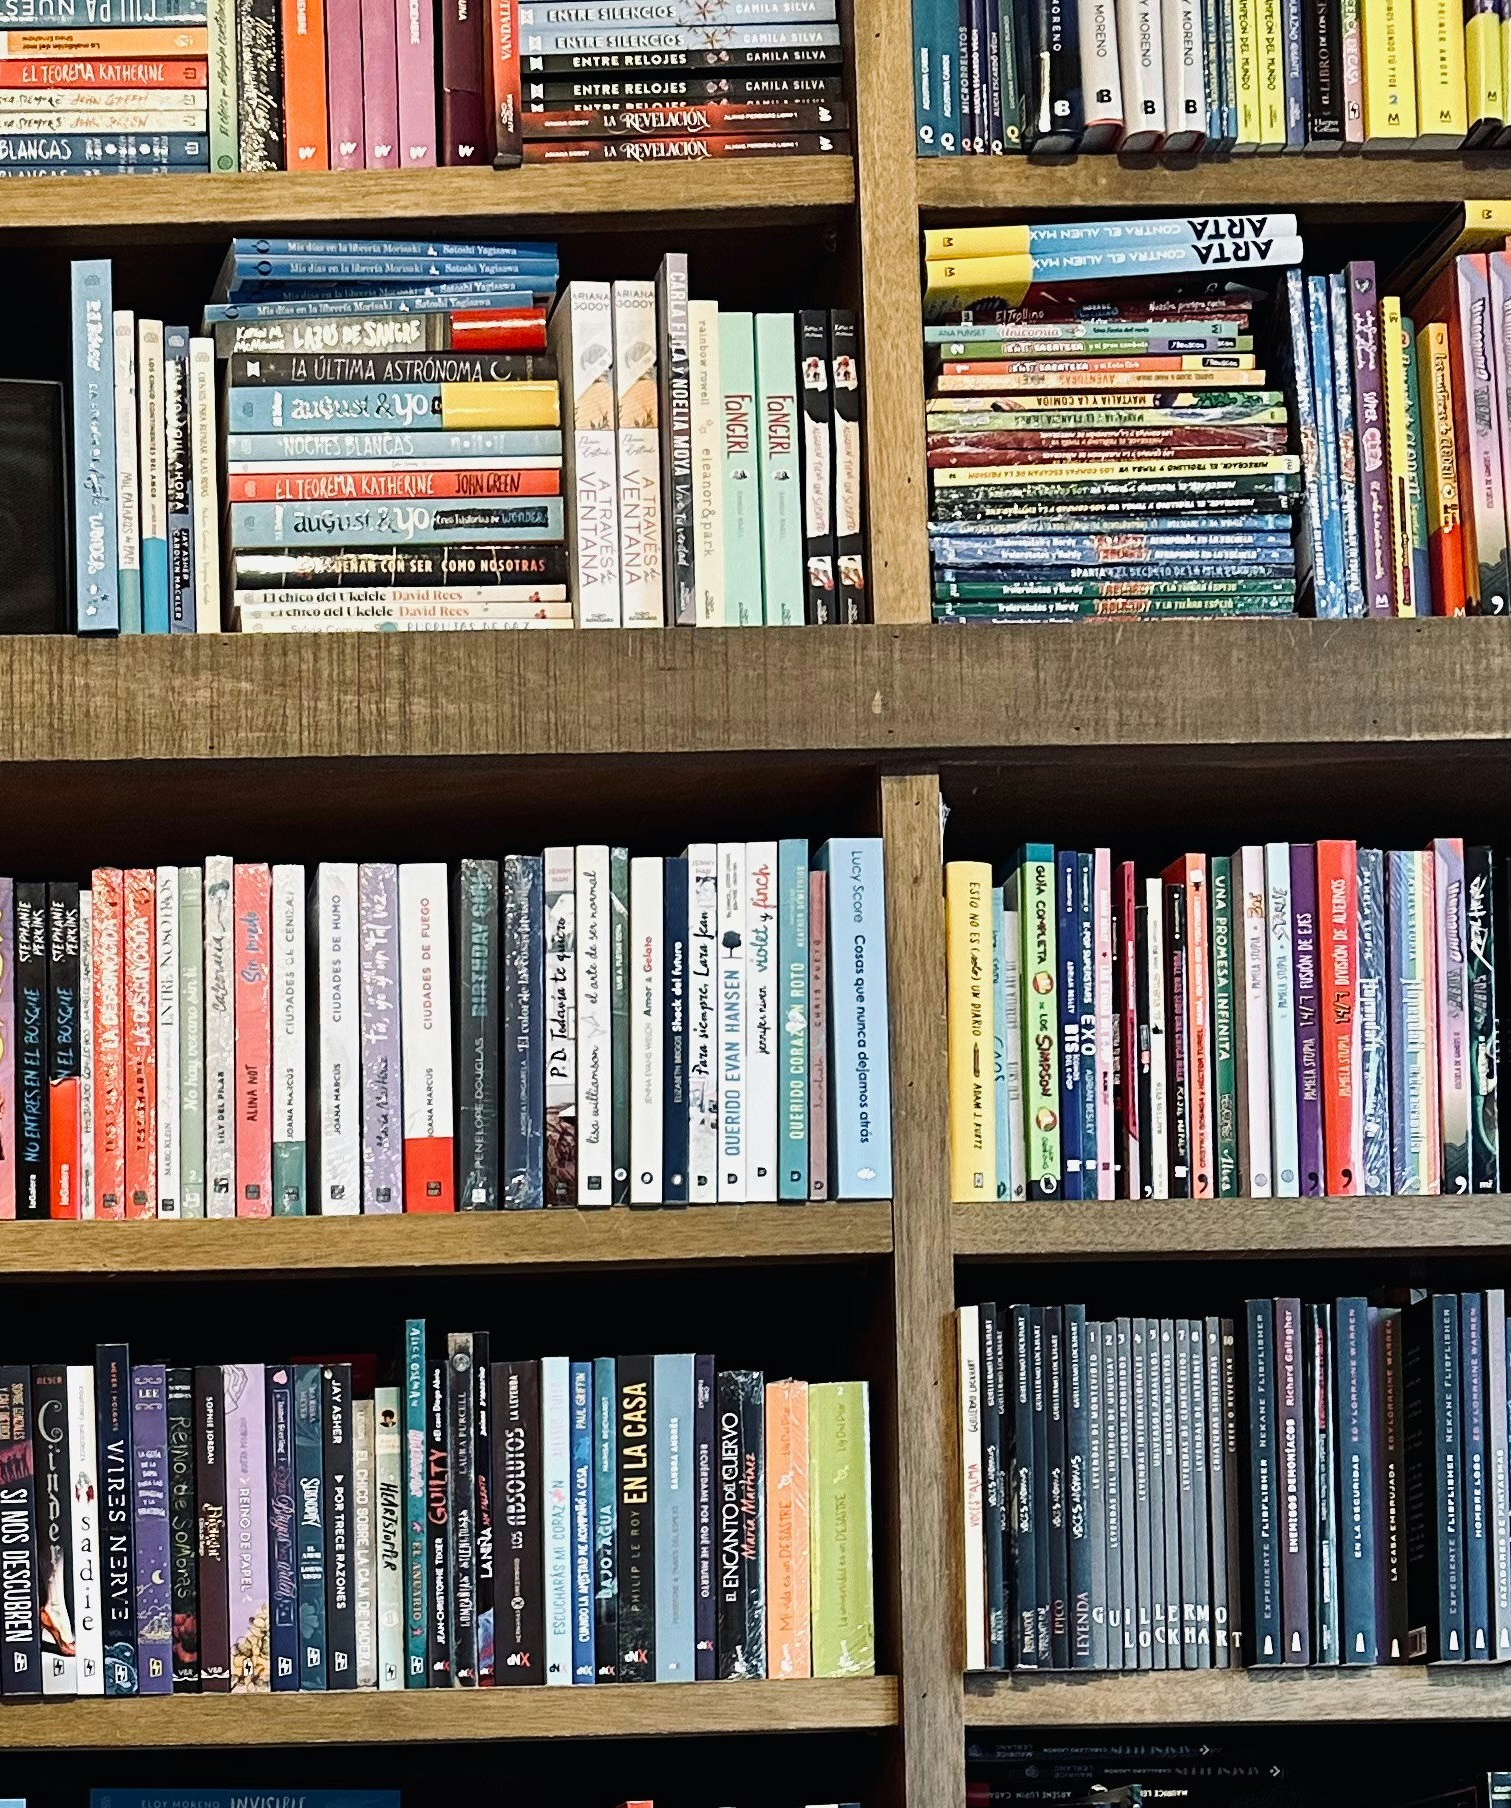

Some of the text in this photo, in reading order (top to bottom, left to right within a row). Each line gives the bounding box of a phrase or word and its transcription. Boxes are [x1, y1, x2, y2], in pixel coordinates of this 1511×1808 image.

[21, 64, 40, 84] EL
[42, 63, 93, 83] TEOREMA
[97, 62, 166, 84] KATHERINE
[573, 52, 688, 69] ENTRE RELOJES
[746, 49, 826, 63] CAMILA SILVA
[604, 110, 711, 133] LA REVELACIÓN
[290, 264, 304, 274] Mis
[306, 263, 325, 274] días
[327, 265, 339, 274] en
[342, 263, 351, 274] la
[352, 263, 384, 275] librería
[1030, 238, 1274, 269] ARTA CONTRA EL ALIEN MAX
[291, 355, 484, 383] LA ÚLTIMA ASTRÓNOMA
[292, 321, 422, 349] LAZOS DE SANGRE
[700, 448, 715, 558] eleanor&park
[263, 589, 463, 602] El chico del Ukelele David Rees
[331, 894, 342, 1023] CIUDADES DE HUMO
[851, 850, 870, 1145] Lucy Score Cosas que nunca dejamos atrás
[1215, 875, 1230, 1061] UNA PROMESA INFINITA
[25, 986, 41, 1163] NO ENTRES EN EL BOSQUE
[722, 971, 741, 1157] QUERIDO EVAN HANSEN
[1080, 1014, 1097, 1059] EXO
[622, 1381, 648, 1504] EN LA CASA
[1284, 1310, 1298, 1553] ENEMIGOS DEMONÍACOS Richard Gallagher
[107, 1439, 130, 1620] WIRES NERVE
[430, 1448, 448, 1526] GUILTY
[0, 1488, 33, 1643] SI NOS DESCUBREN
[333, 1485, 348, 1610] POR TRECE RAZONES
